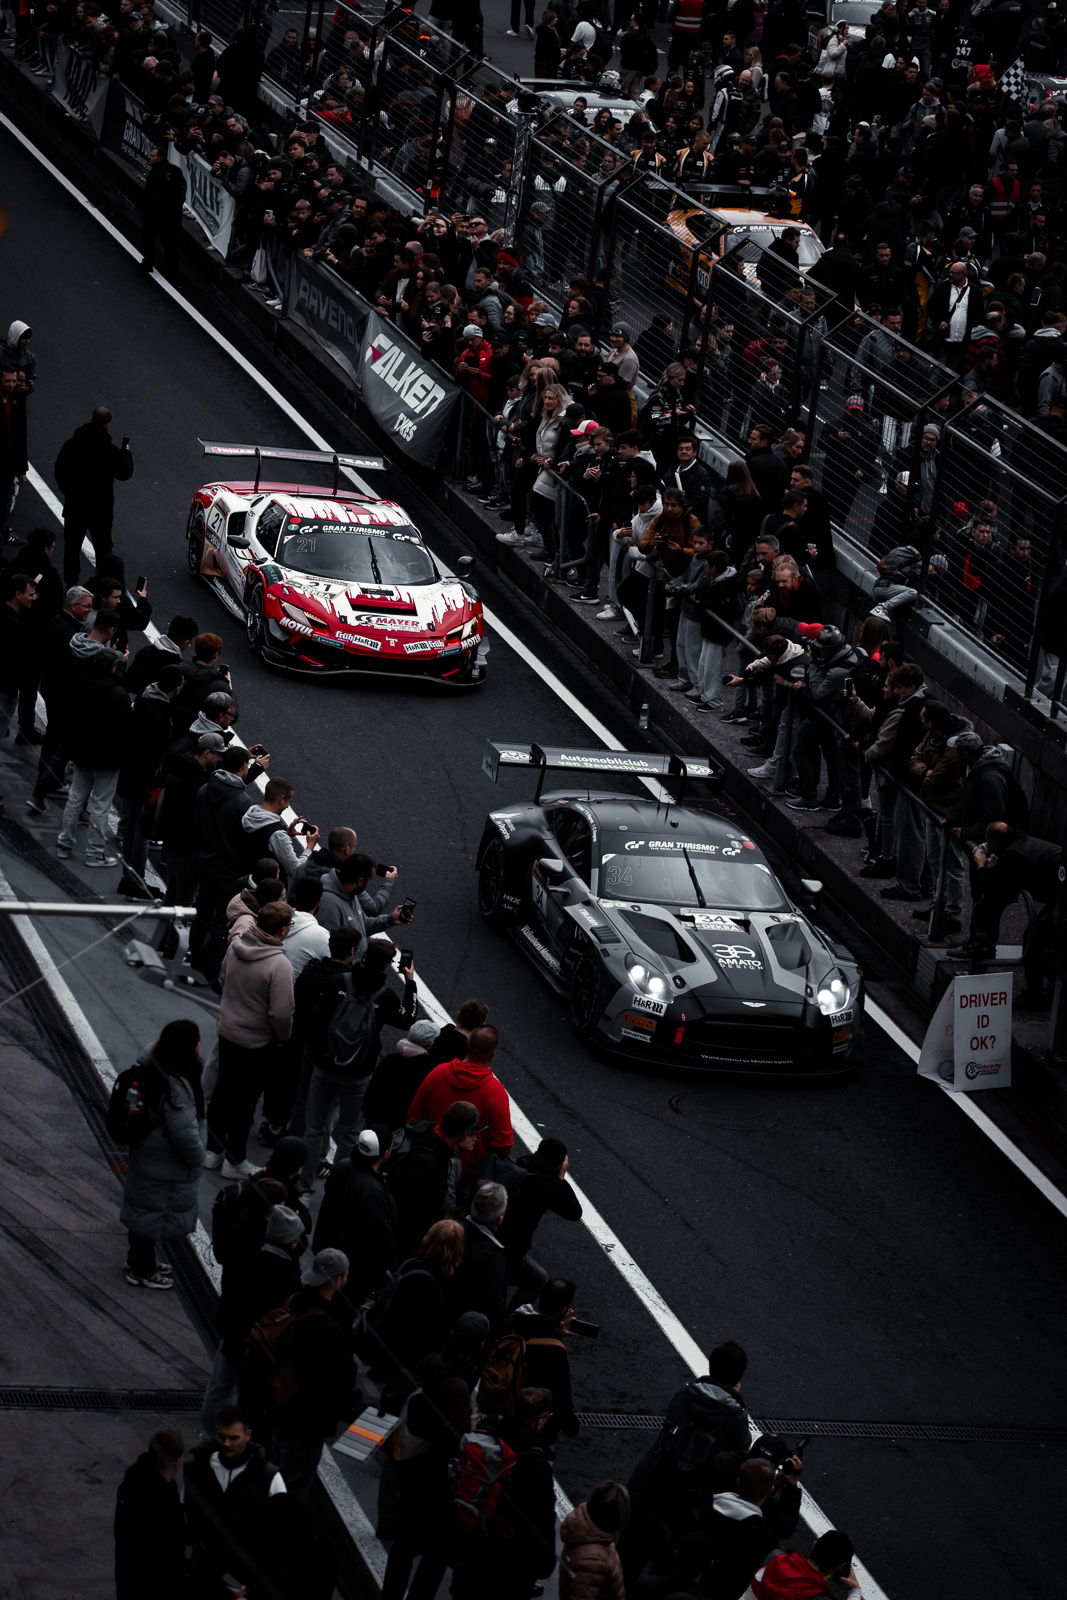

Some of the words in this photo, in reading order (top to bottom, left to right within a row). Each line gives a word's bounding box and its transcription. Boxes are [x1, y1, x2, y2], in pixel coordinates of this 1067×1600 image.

[955, 46, 972, 57] 247
[698, 270, 709, 288] 910
[299, 276, 361, 353] RAVENOL
[364, 333, 446, 419] FALKEN
[211, 512, 223, 534] 21
[296, 537, 317, 553] 21
[300, 585, 331, 600] DEKRA
[307, 581, 332, 592] 21
[279, 617, 314, 638] MOTUL
[375, 617, 420, 628] MAYER
[560, 753, 649, 768] Automobilclub
[583, 761, 659, 773] Deutschland
[648, 840, 674, 849] GRAN
[676, 841, 716, 852] TURISMO
[607, 865, 634, 887] 34
[535, 884, 544, 908] 34
[698, 914, 728, 924] 34
[718, 958, 762, 967] AMATO
[960, 991, 1008, 1009] DRIVER
[977, 1014, 990, 1029] ID
[970, 1035, 996, 1051] OK?
[700, 1053, 750, 1064] Walkenhorst
[750, 1058, 794, 1066] Motorsport
